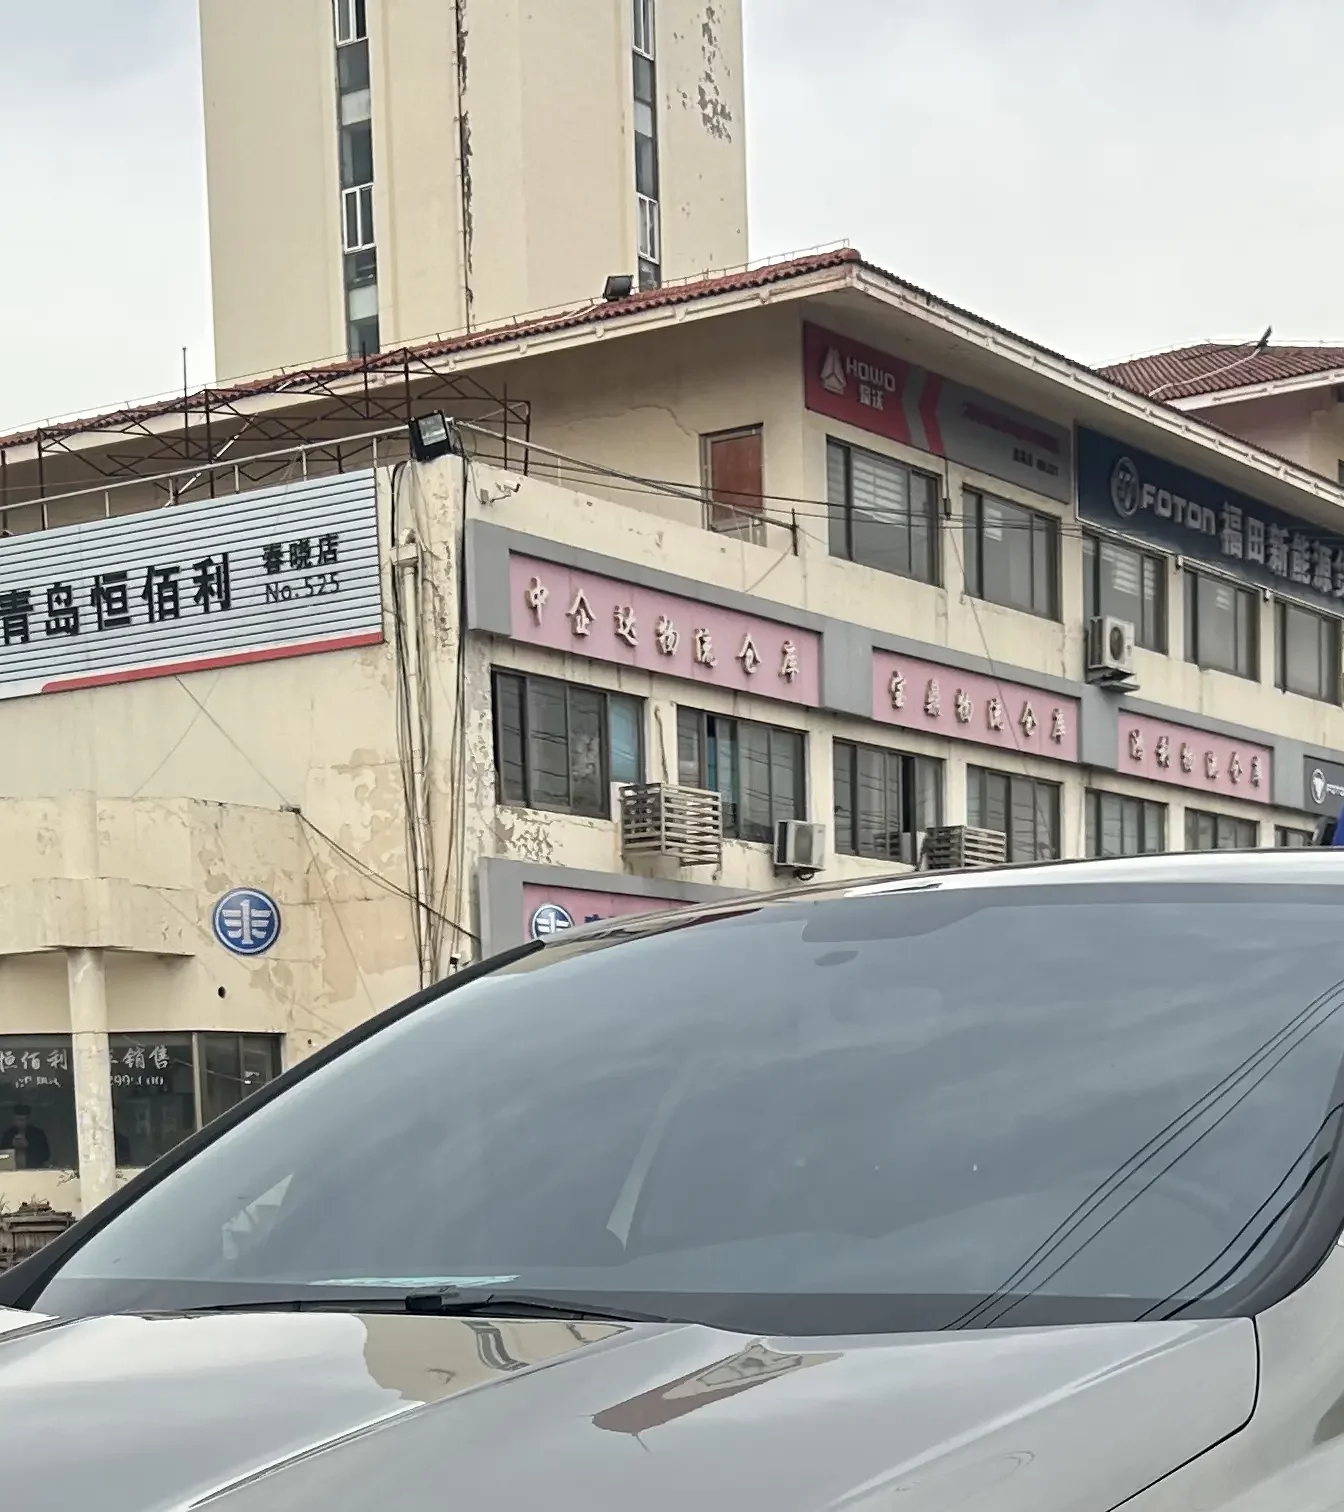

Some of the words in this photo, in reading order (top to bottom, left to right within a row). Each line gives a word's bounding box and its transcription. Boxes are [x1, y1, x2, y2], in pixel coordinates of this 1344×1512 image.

[845, 355, 897, 392] HOWO
[1141, 482, 1216, 536] FOTON
[262, 533, 340, 575] 春晓店
